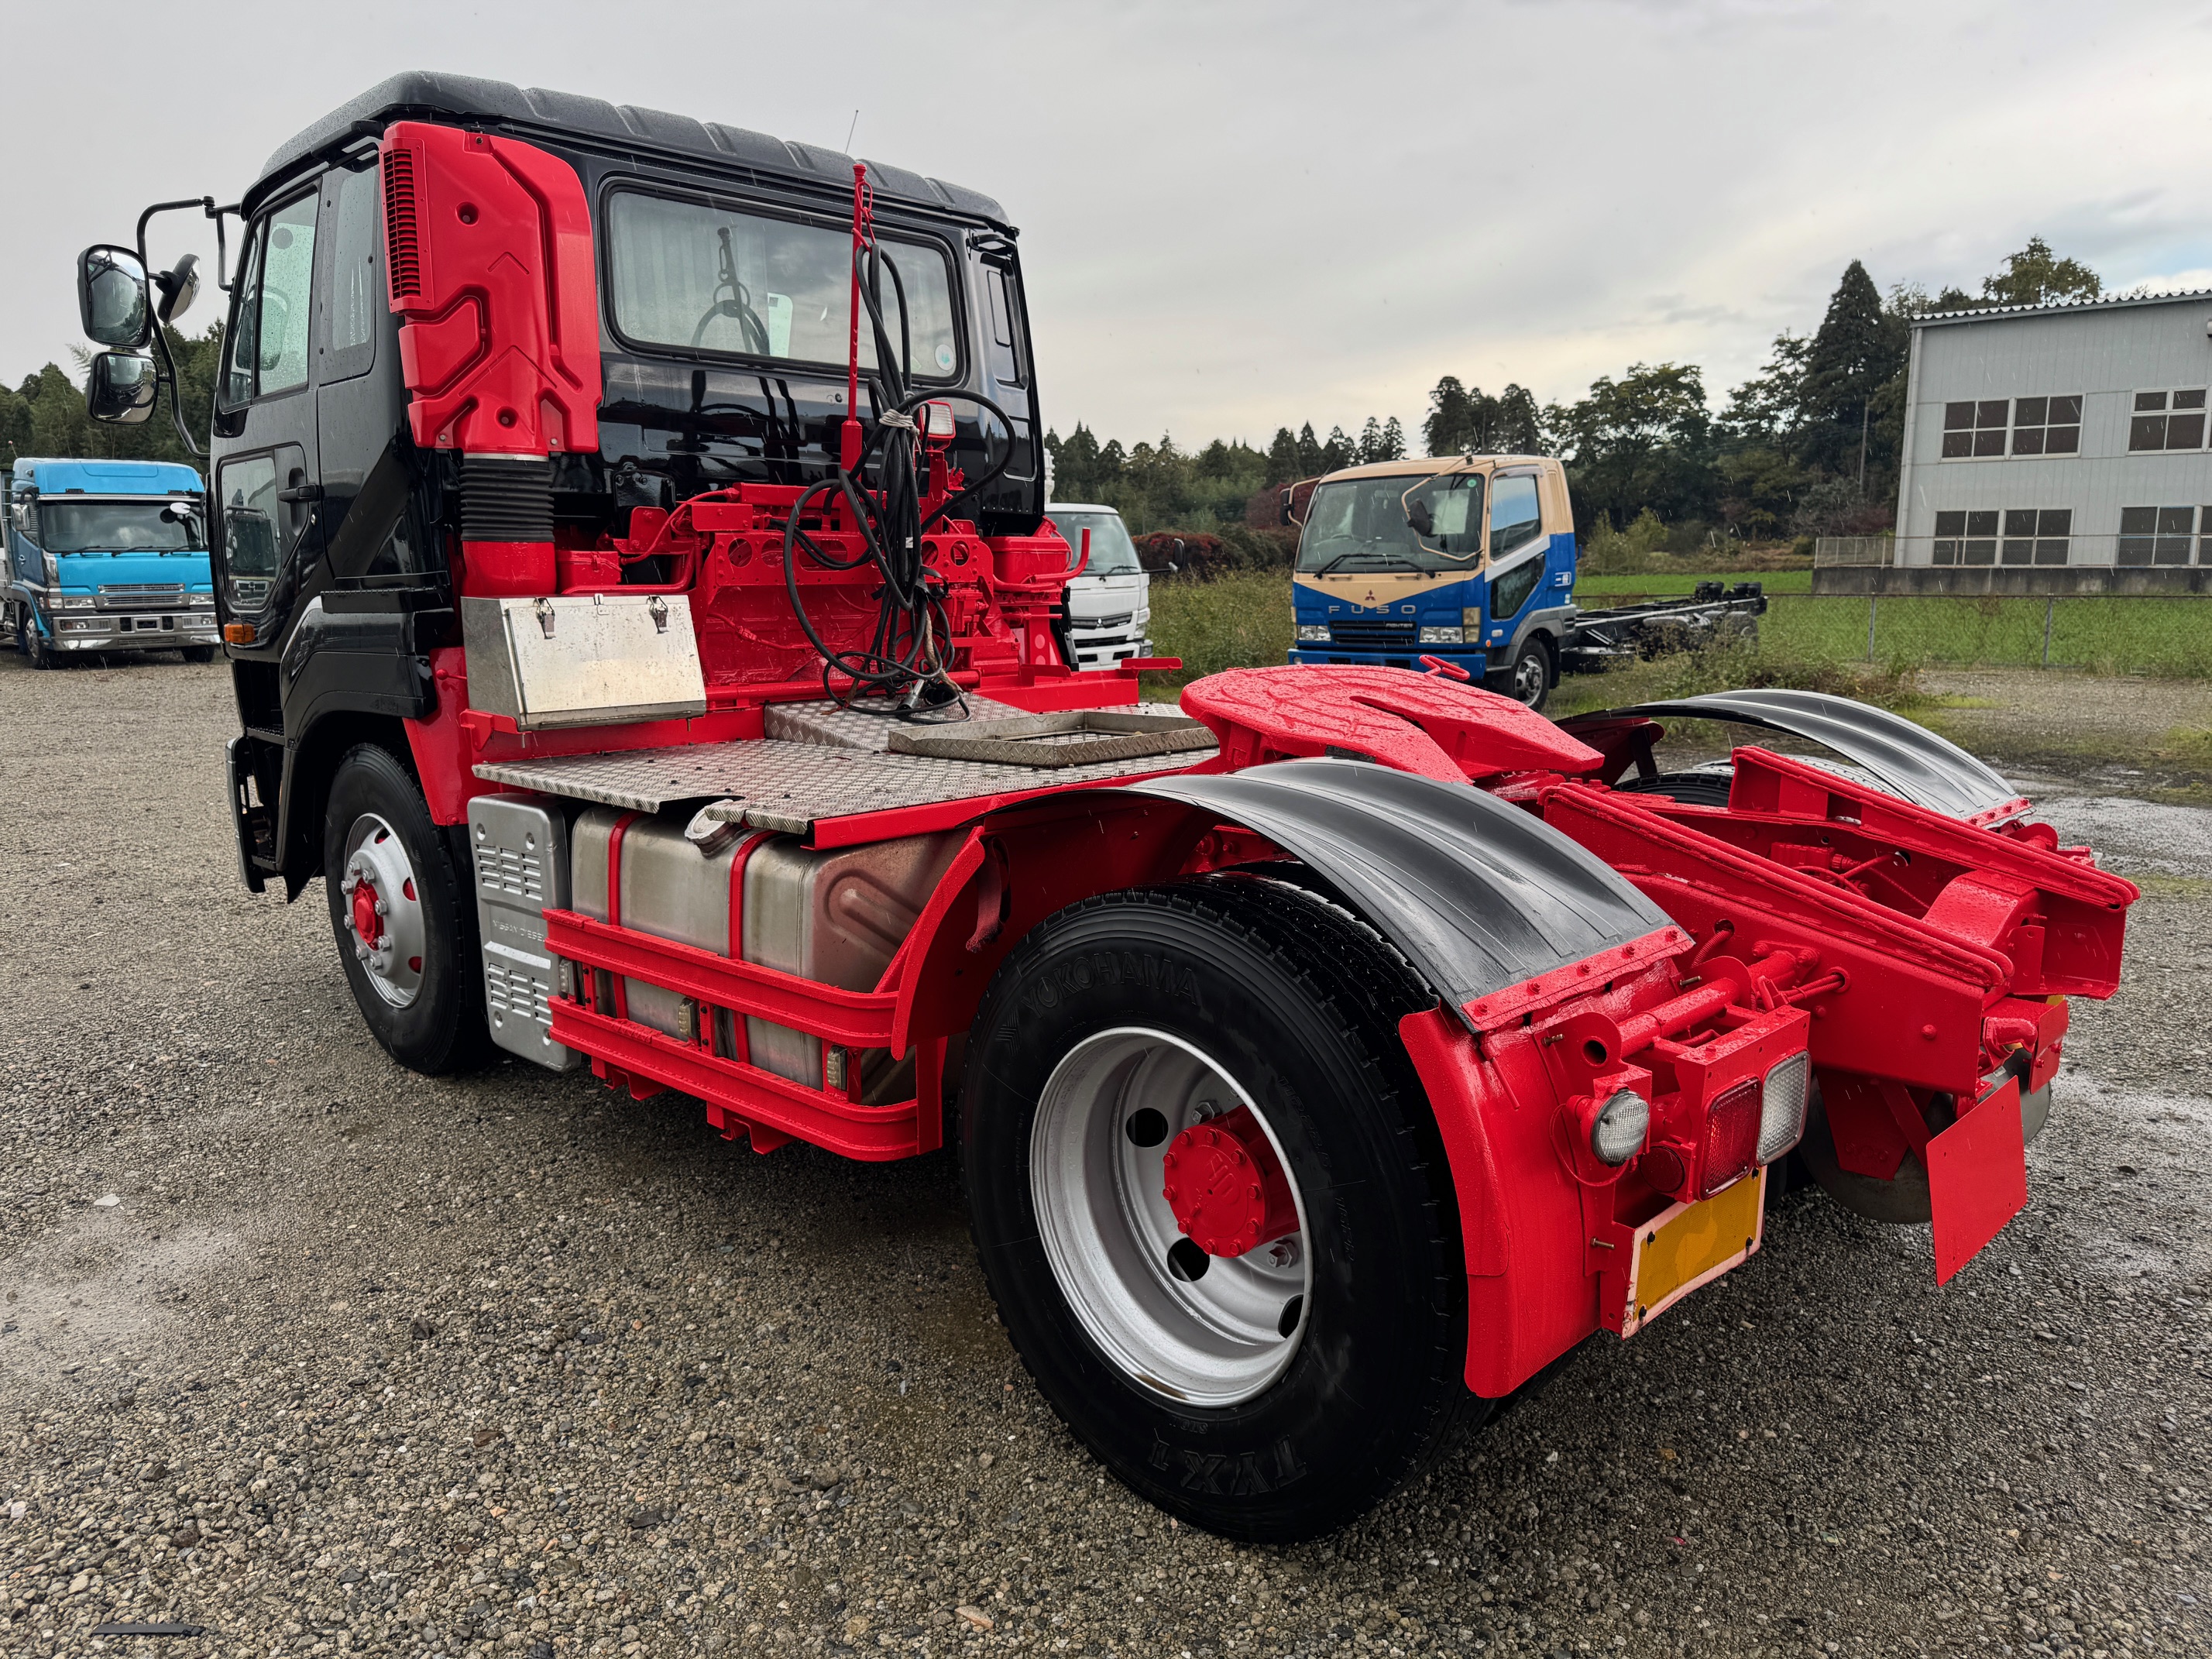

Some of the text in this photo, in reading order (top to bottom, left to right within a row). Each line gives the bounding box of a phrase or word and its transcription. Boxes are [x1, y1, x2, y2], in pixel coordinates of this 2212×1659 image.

[1328, 605, 1416, 614] FUSO
[493, 919, 518, 933] NISSAN
[1020, 951, 1201, 1018] YOKOHAMA
